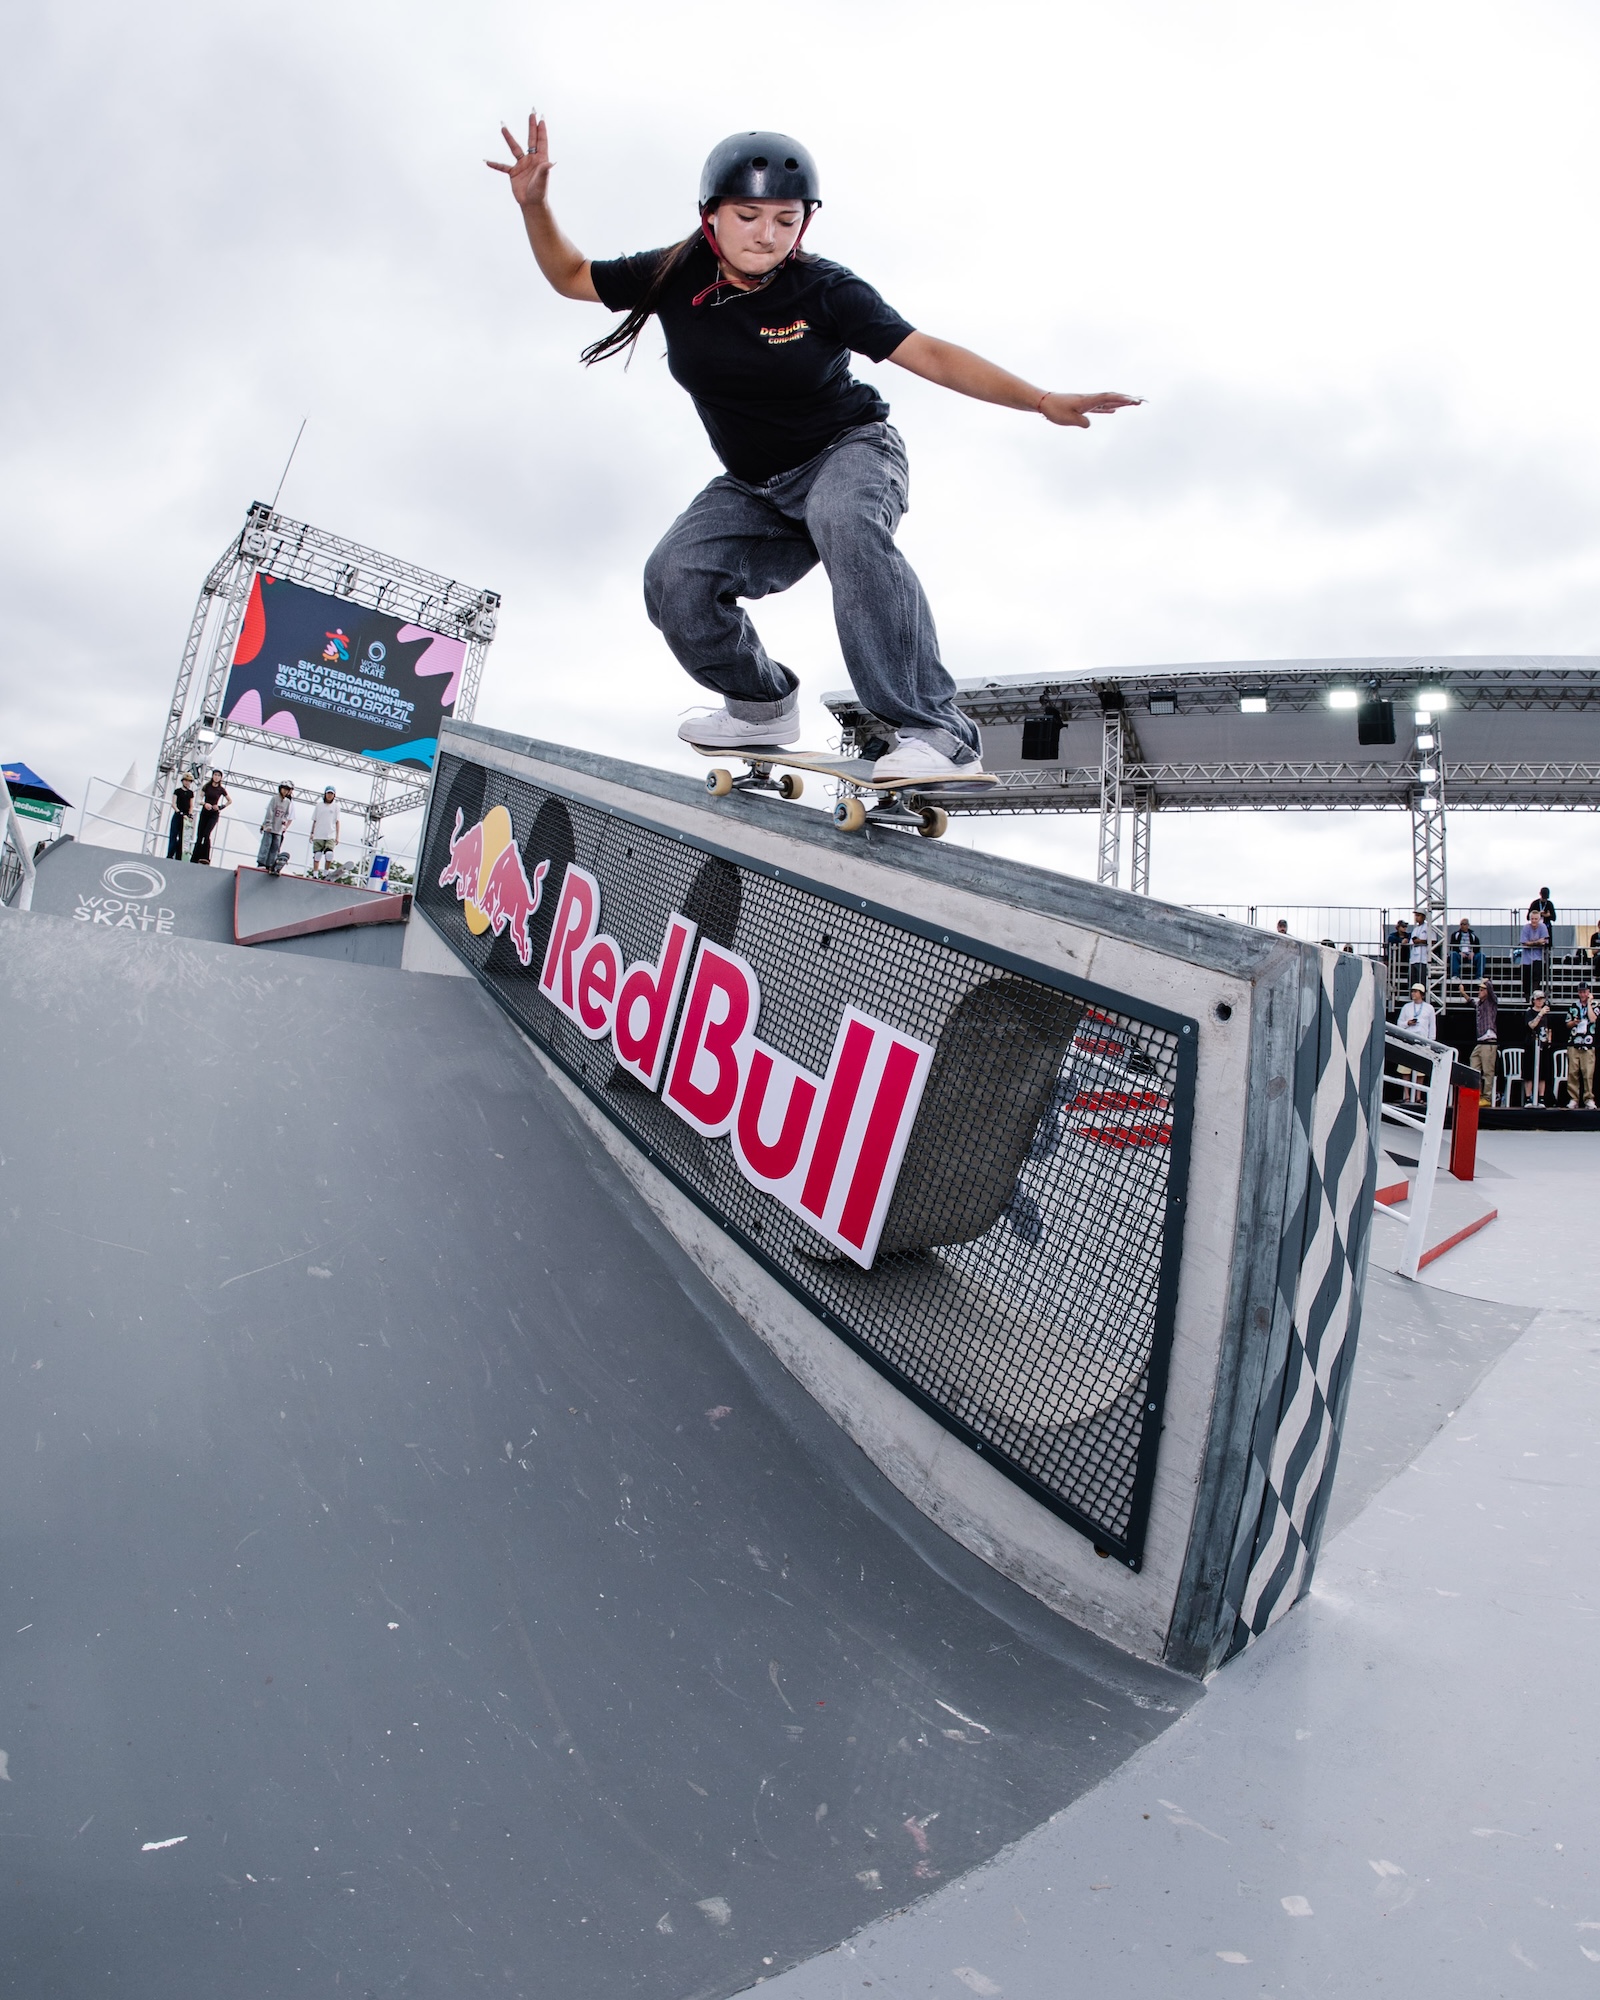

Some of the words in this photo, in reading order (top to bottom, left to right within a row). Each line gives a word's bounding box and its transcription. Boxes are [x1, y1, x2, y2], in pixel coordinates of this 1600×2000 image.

[768, 331, 804, 344] COMPANY
[297, 659, 400, 698] SKATEBOARDING
[359, 665, 385, 679] SKATE
[360, 659, 386, 672] WORLD
[274, 673, 310, 693] SÃO
[310, 683, 362, 708] PAULO
[362, 699, 412, 723] BRAZIL
[278, 663, 321, 683] WORLD
[323, 677, 415, 712] CHAMPIONSHIPS
[280, 689, 333, 709] PARK/STREET
[357, 711, 385, 725] MARCH
[384, 720, 403, 730] 2026
[72, 906, 175, 935] SKATE
[78, 893, 176, 921] WORLD
[541, 869, 691, 1083] Red
[666, 945, 923, 1252] Bull
